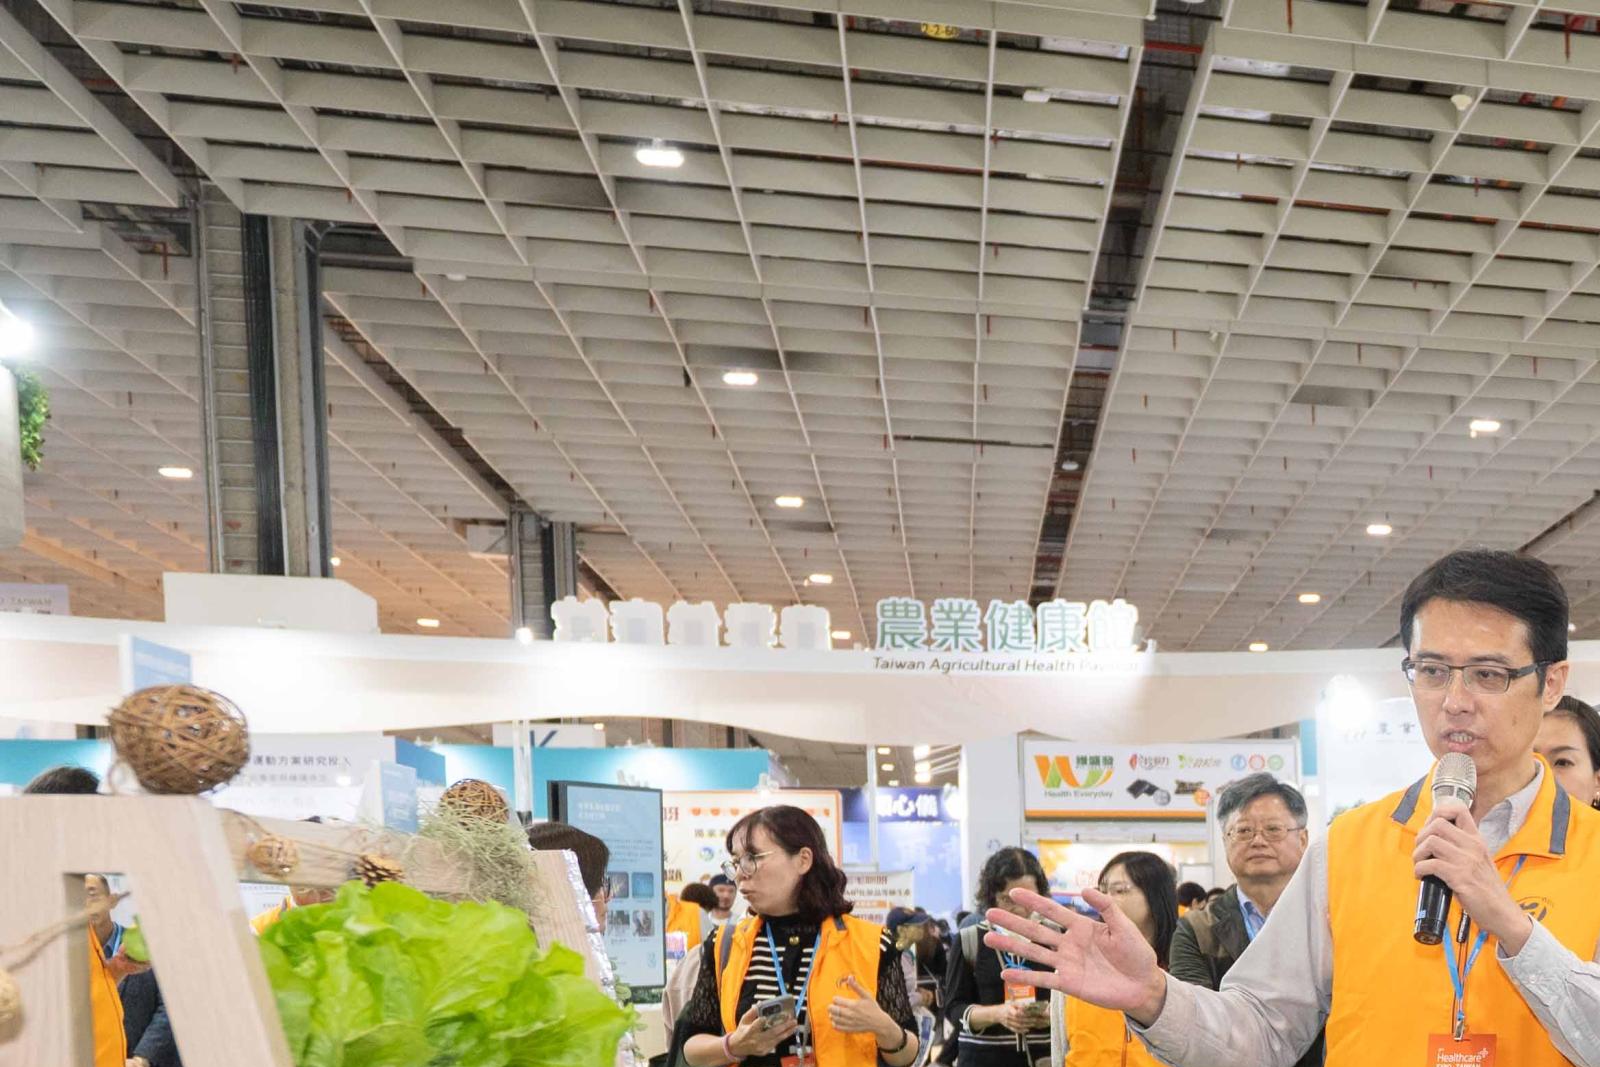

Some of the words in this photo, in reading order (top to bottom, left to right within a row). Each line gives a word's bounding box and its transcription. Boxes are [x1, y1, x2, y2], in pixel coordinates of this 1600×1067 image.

[873, 656, 925, 670] Taiwan
[930, 657, 1021, 675] Agricultural
[1025, 659, 1075, 672] Health
[1044, 790, 1072, 798] Health
[1074, 790, 1113, 799] Everyday
[1437, 1052, 1482, 1063] Healthcare
